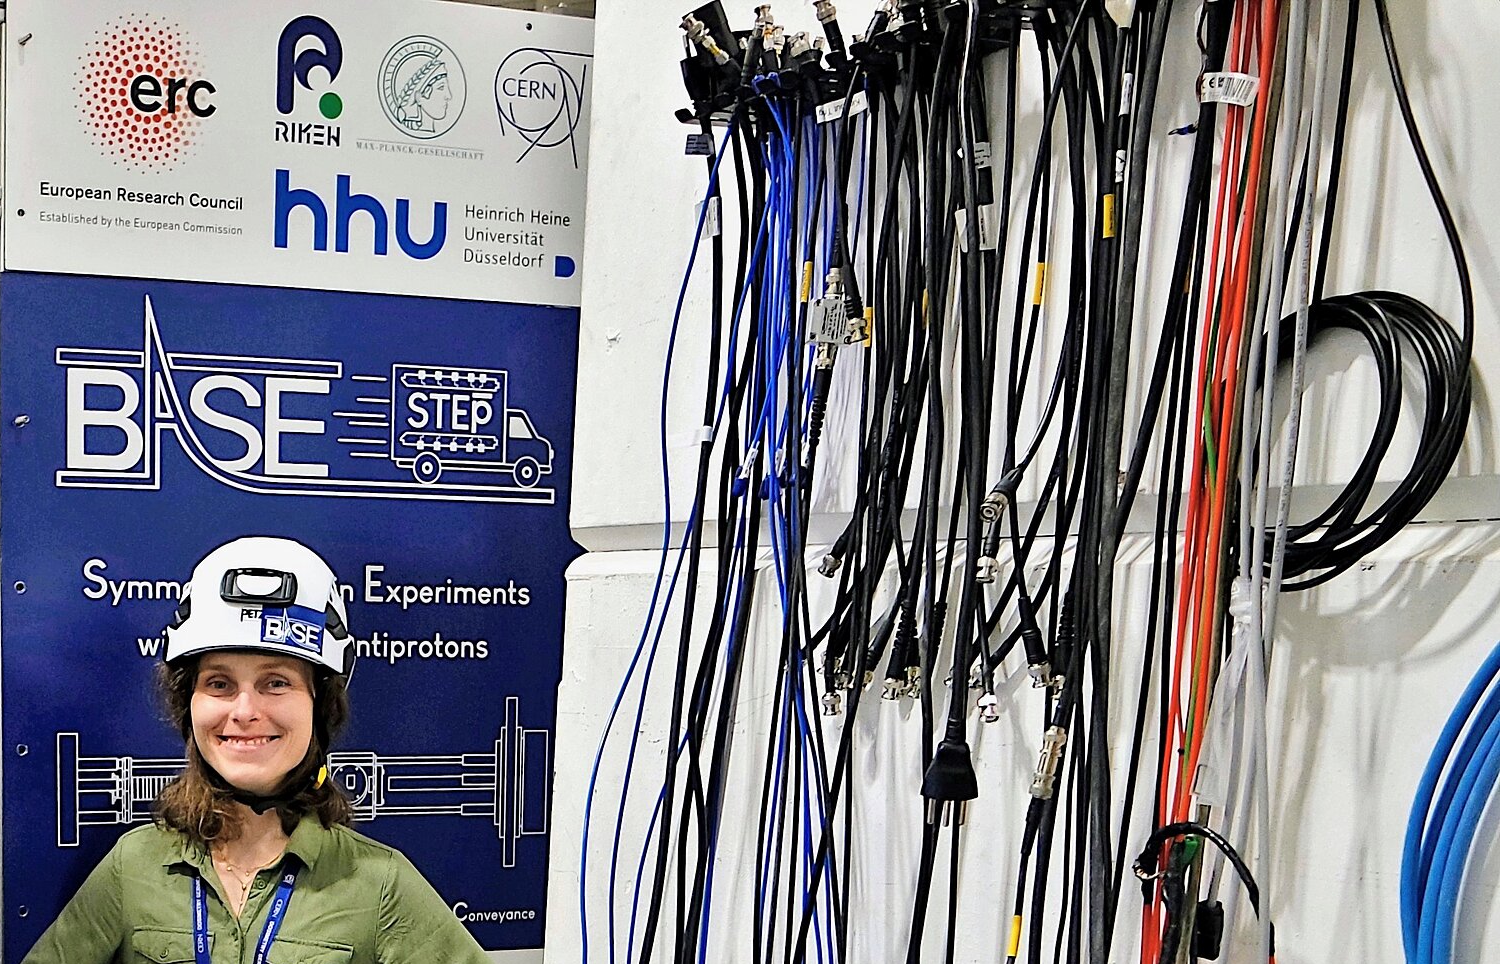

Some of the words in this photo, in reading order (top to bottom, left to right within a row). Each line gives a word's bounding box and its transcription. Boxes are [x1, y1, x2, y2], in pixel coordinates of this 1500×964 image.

[129, 73, 217, 118] erc
[502, 77, 556, 101] CERN
[275, 120, 341, 147] RIKEN
[355, 140, 485, 161] MAX-PLANCK-GESELLSCHAFT
[40, 182, 112, 200] European
[116, 187, 185, 206] Research
[189, 193, 243, 210] Council
[39, 211, 98, 225] Established
[100, 215, 112, 228] by
[115, 217, 131, 228] the
[133, 217, 180, 231] European
[183, 221, 243, 236] Commission
[274, 169, 447, 260] hhu
[465, 205, 525, 223] Heinrich
[530, 210, 571, 226] Heine
[464, 227, 544, 246] Universität
[463, 249, 544, 269] Düsseldorf
[63, 320, 332, 480] BASE
[365, 565, 530, 609] Experiments
[263, 613, 322, 649] BASE
[355, 633, 489, 665] ntiprotons
[453, 901, 536, 924] Conveyance
